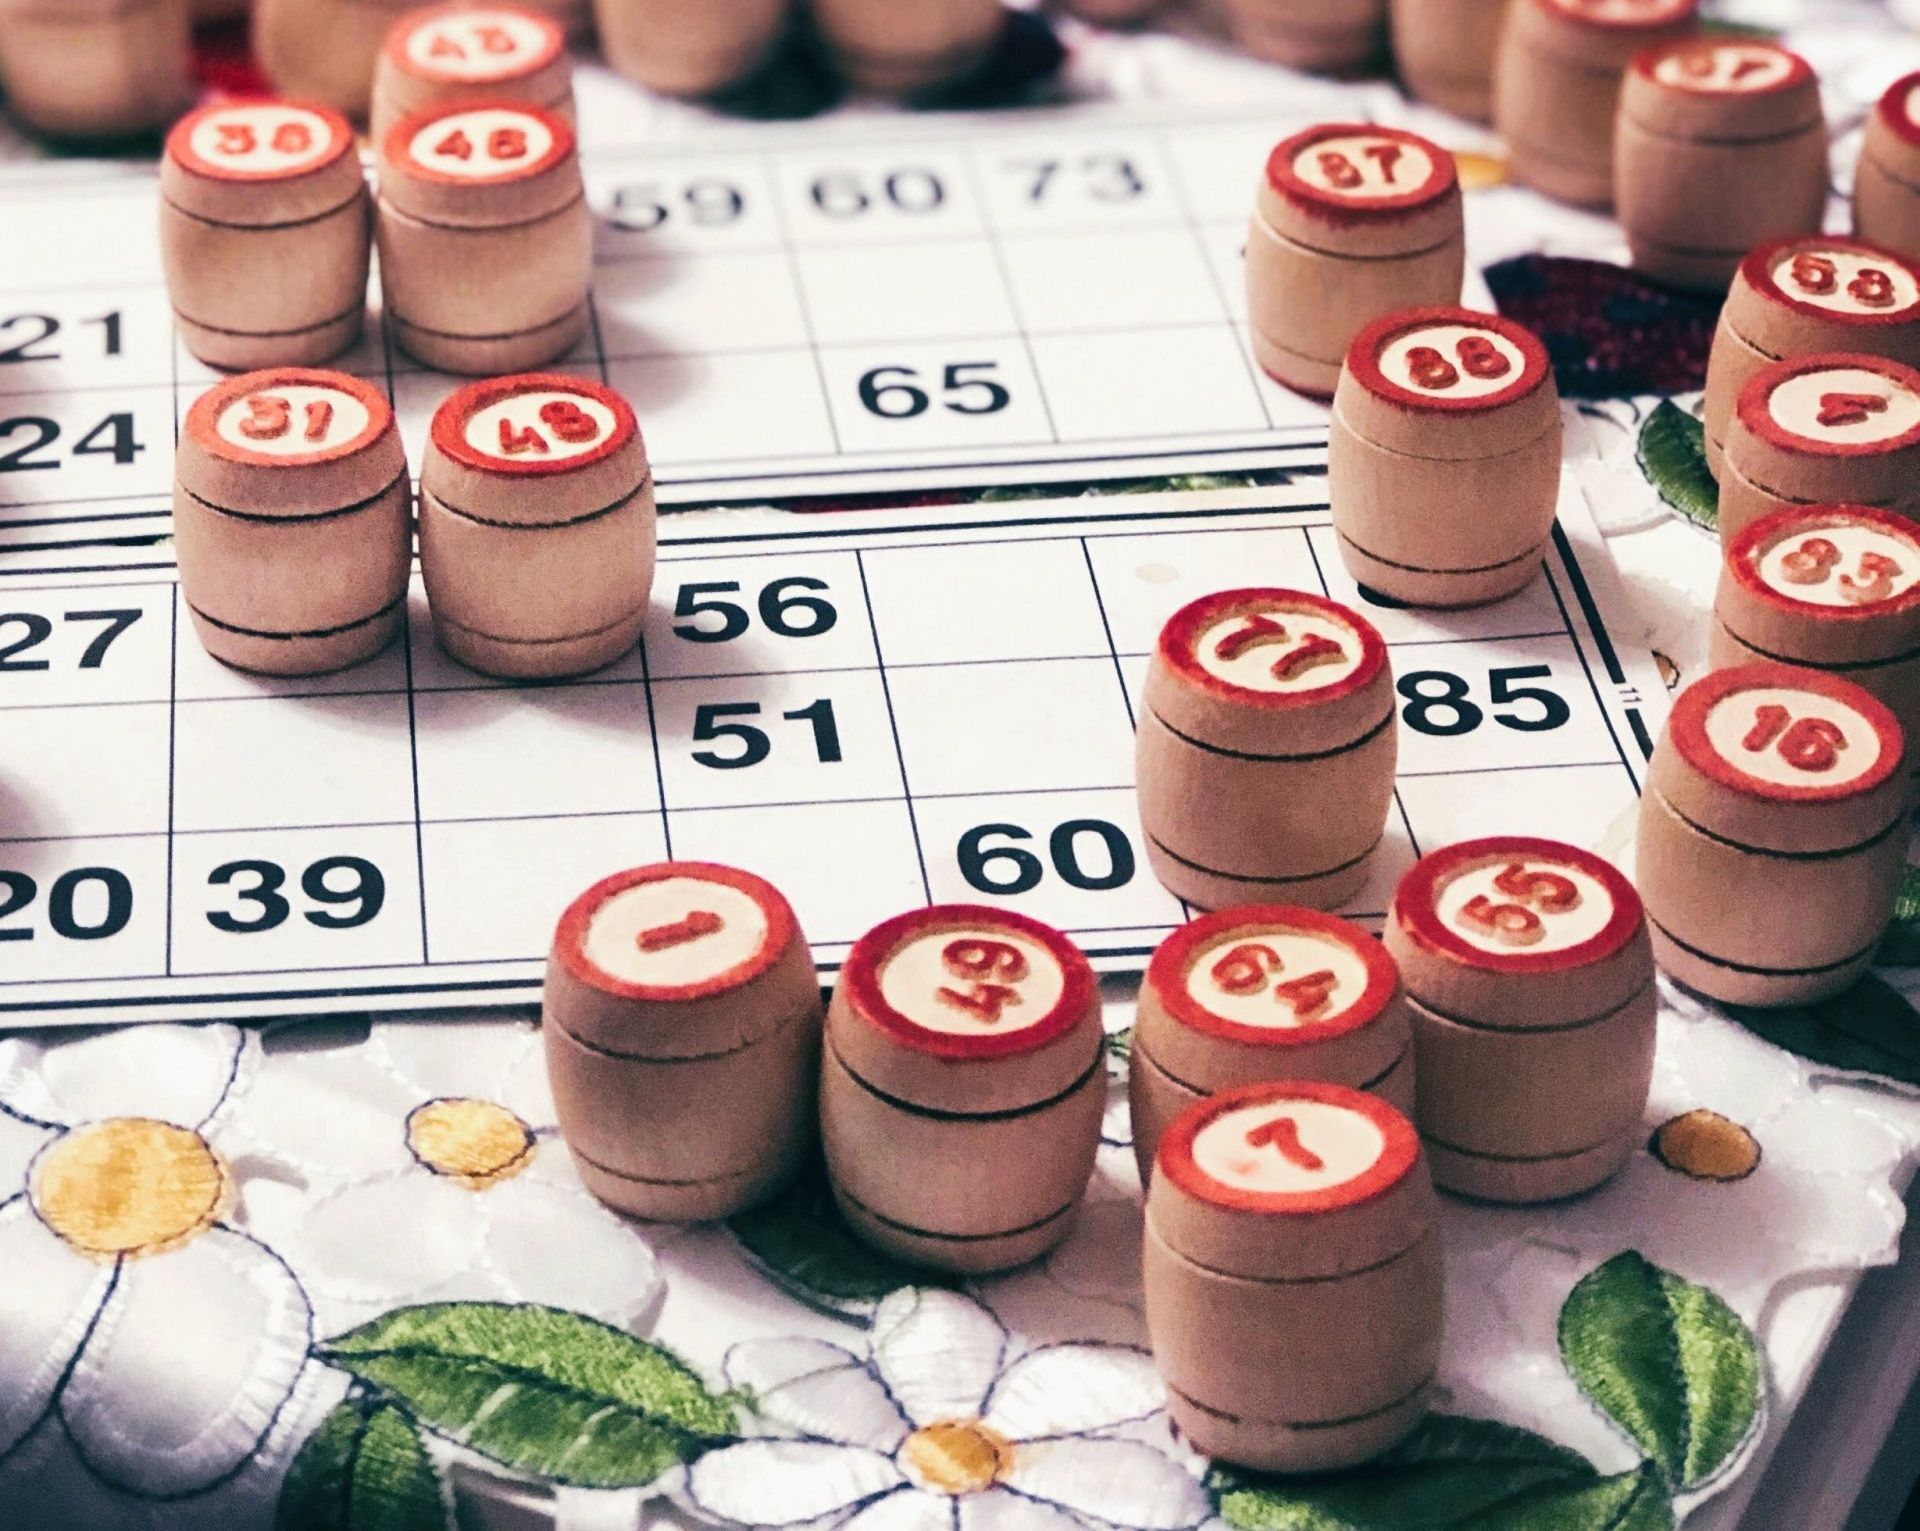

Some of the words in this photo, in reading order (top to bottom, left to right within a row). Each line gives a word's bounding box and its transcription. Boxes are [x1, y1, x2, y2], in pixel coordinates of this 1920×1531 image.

[608, 179, 746, 232] 59
[809, 165, 947, 218] 60
[998, 154, 1147, 204] 73
[0, 311, 121, 365] 21
[1404, 335, 1512, 391] 88
[239, 395, 334, 442] 31
[857, 360, 1011, 419] 65
[0, 411, 146, 473] 24
[498, 400, 600, 455] 48
[0, 609, 143, 672] 27
[672, 576, 839, 643] 56
[1214, 614, 1350, 684] 77
[1396, 664, 1571, 737] 85
[690, 697, 843, 769] 51
[1741, 702, 1848, 773] 16
[956, 818, 1136, 896] 60
[205, 855, 387, 933] 39
[636, 910, 724, 953] 1
[1245, 1116, 1327, 1173] 7
